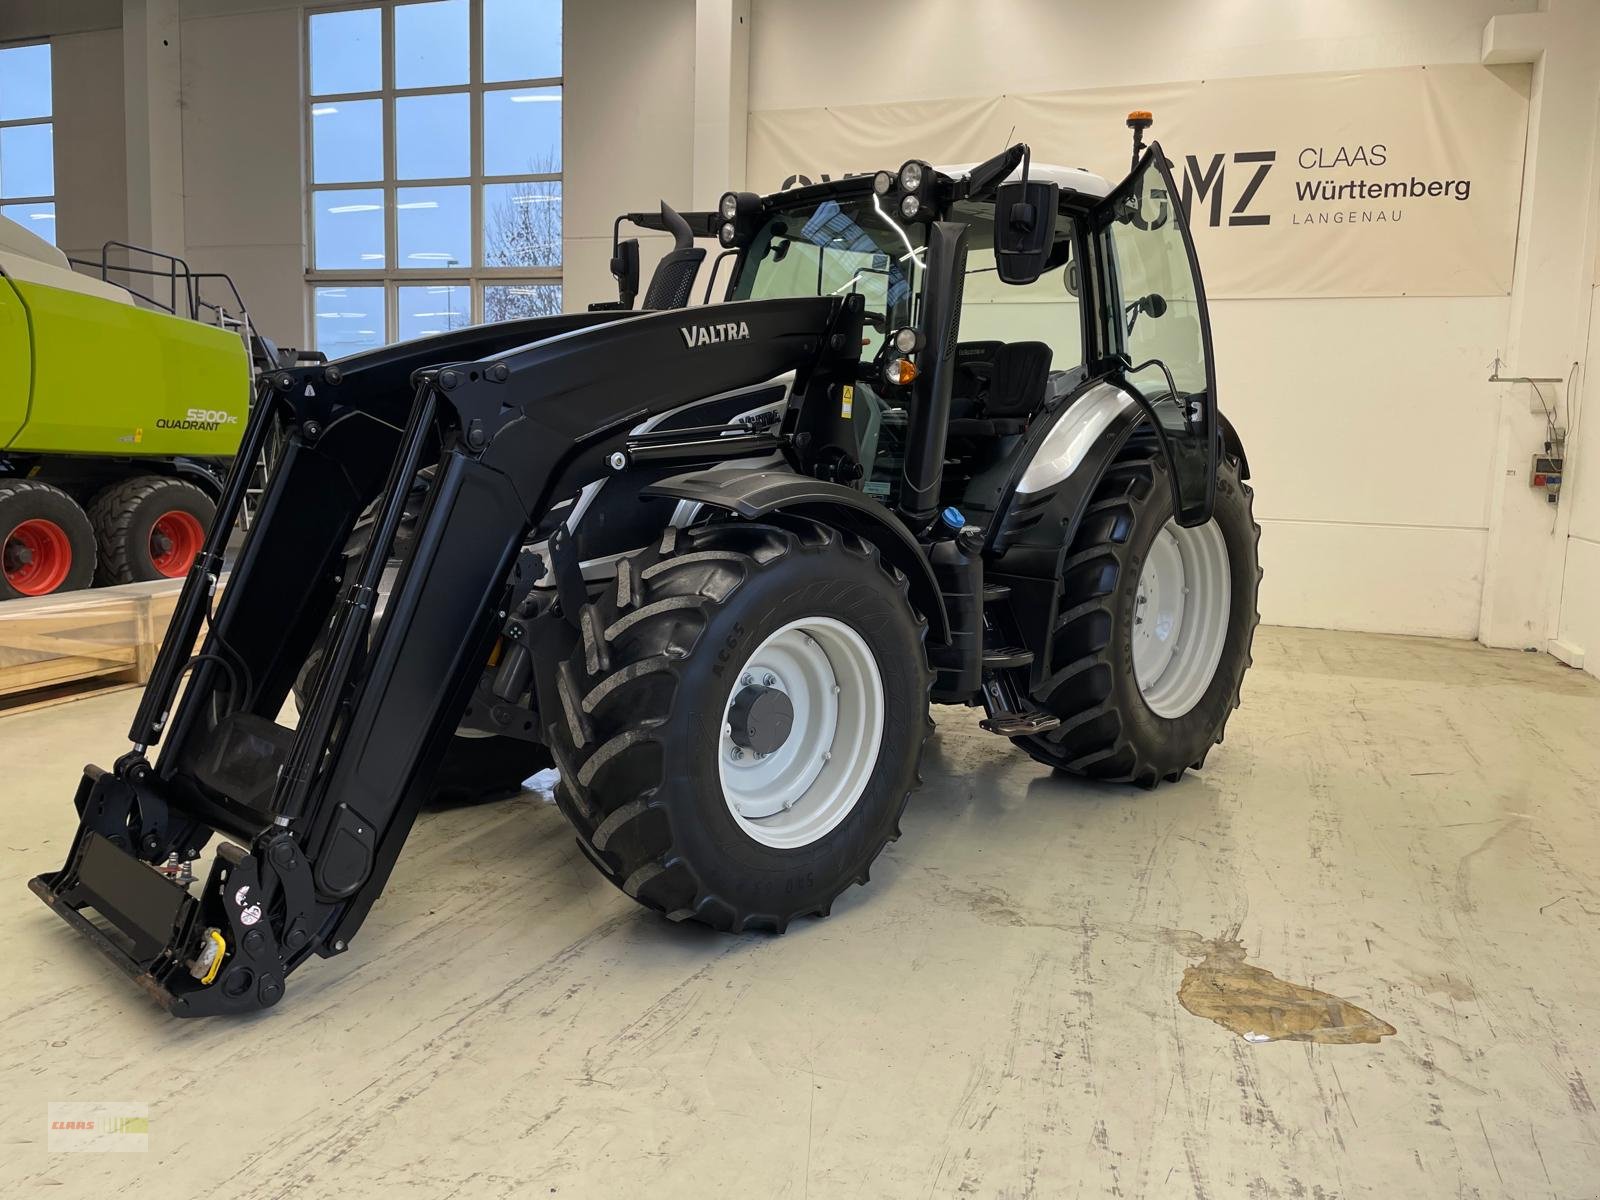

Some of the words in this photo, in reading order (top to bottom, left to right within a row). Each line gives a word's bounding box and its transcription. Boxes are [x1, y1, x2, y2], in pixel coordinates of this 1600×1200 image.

[1298, 144, 1387, 169] CLAAS
[1295, 177, 1471, 201] Württemberg
[1292, 210, 1403, 225] LANGENAU
[681, 322, 750, 348] VALTRA
[156, 418, 220, 431] QUADRANT
[711, 621, 744, 678] AC65
